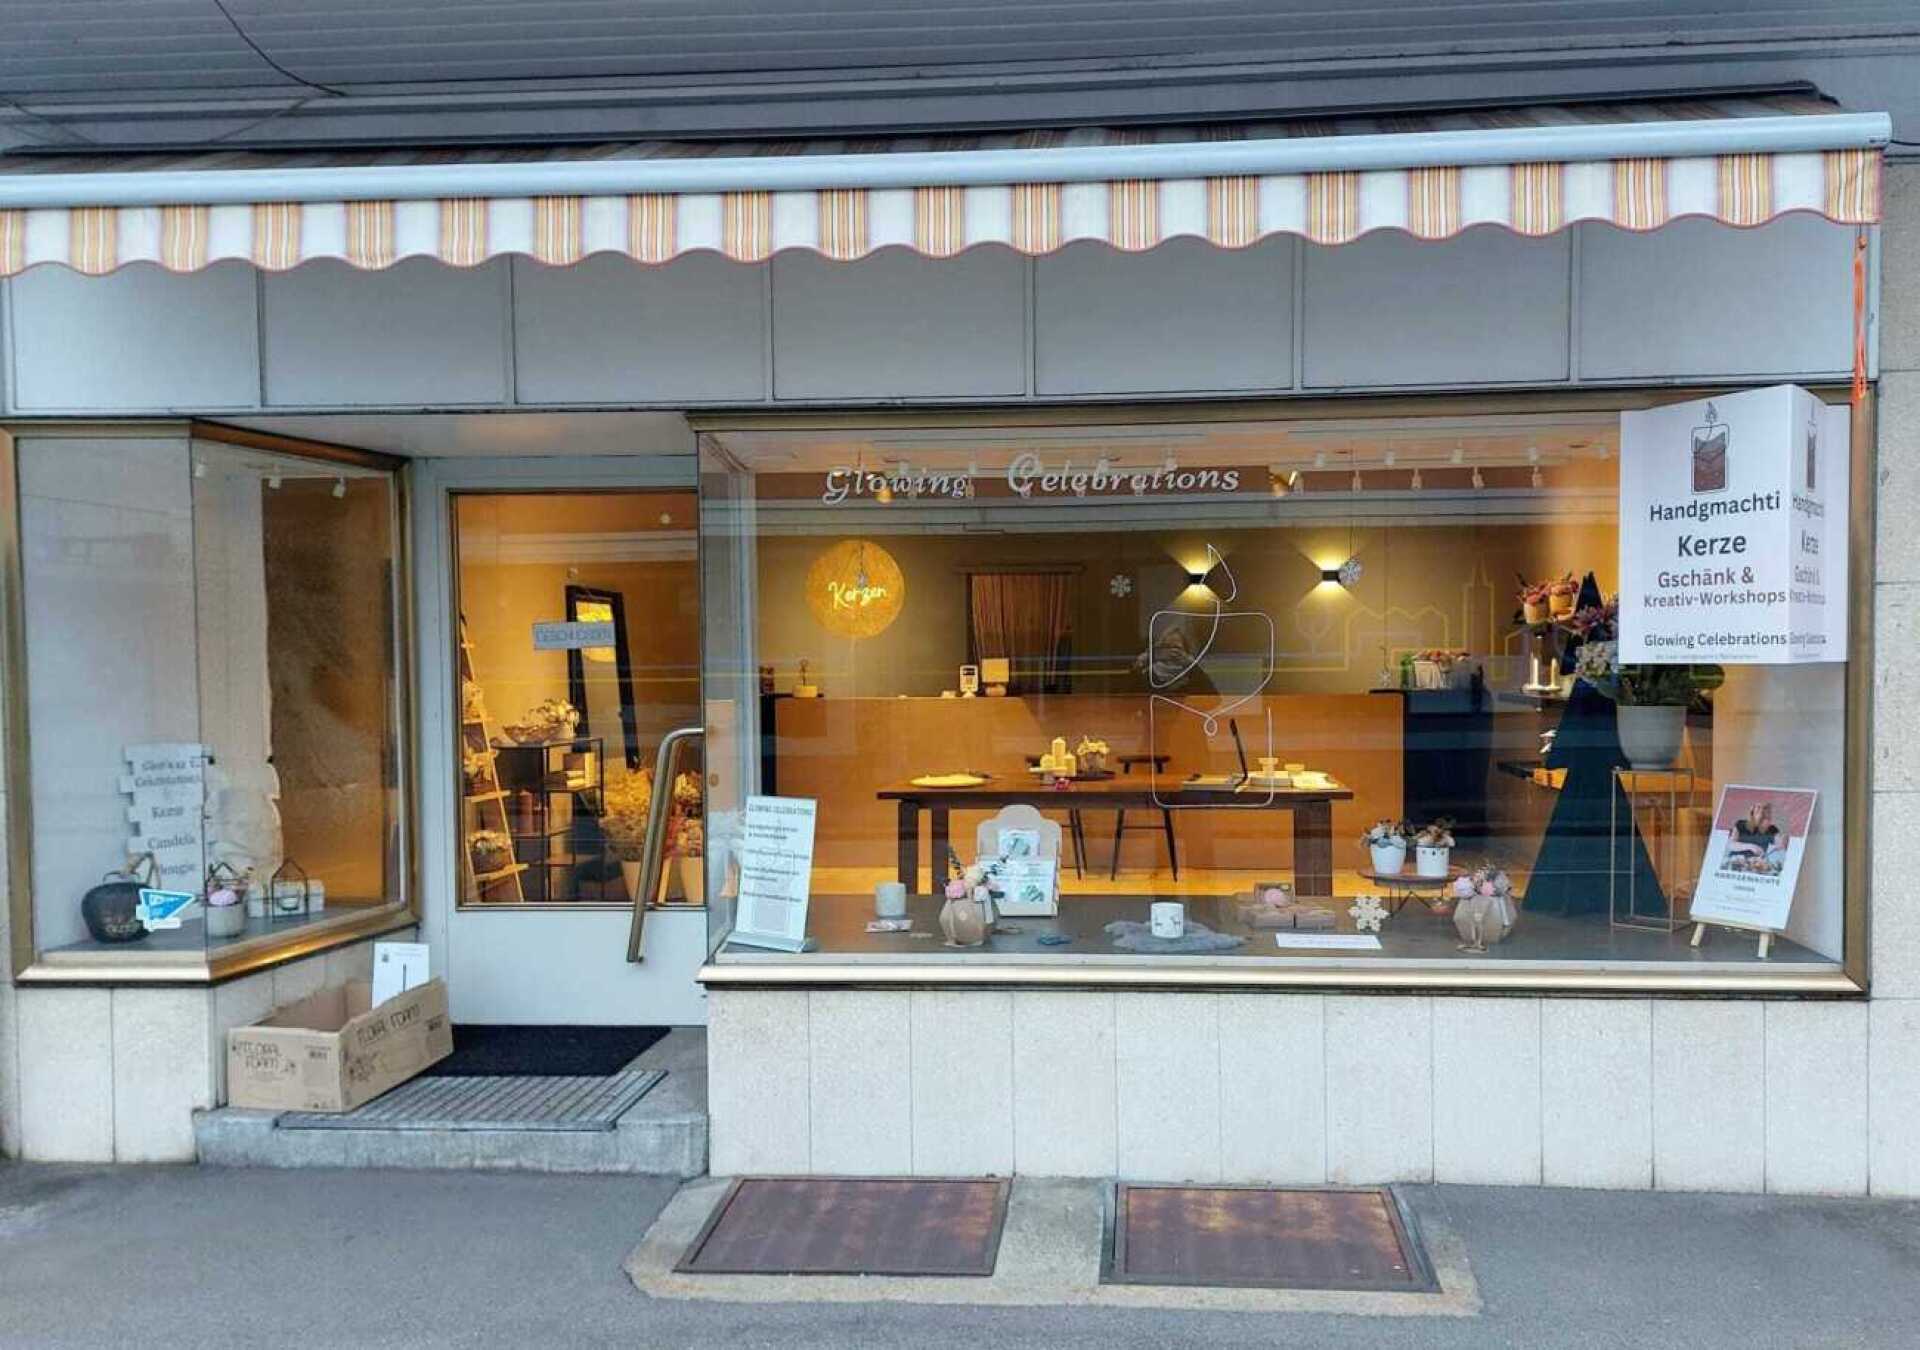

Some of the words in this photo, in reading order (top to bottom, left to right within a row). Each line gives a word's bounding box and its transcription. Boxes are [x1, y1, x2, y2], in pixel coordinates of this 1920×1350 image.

[823, 464, 968, 504] Glowing
[1008, 453, 1239, 493] Celebrations
[1650, 491, 1781, 522] Handgmachti
[1677, 534, 1747, 557] Kerze
[1657, 568, 1735, 588] Gschänk
[1741, 566, 1754, 584] &
[1643, 588, 1787, 608] Kreativ-Workshops
[1644, 633, 1695, 648] Glowing
[1697, 632, 1787, 647] Celebrations
